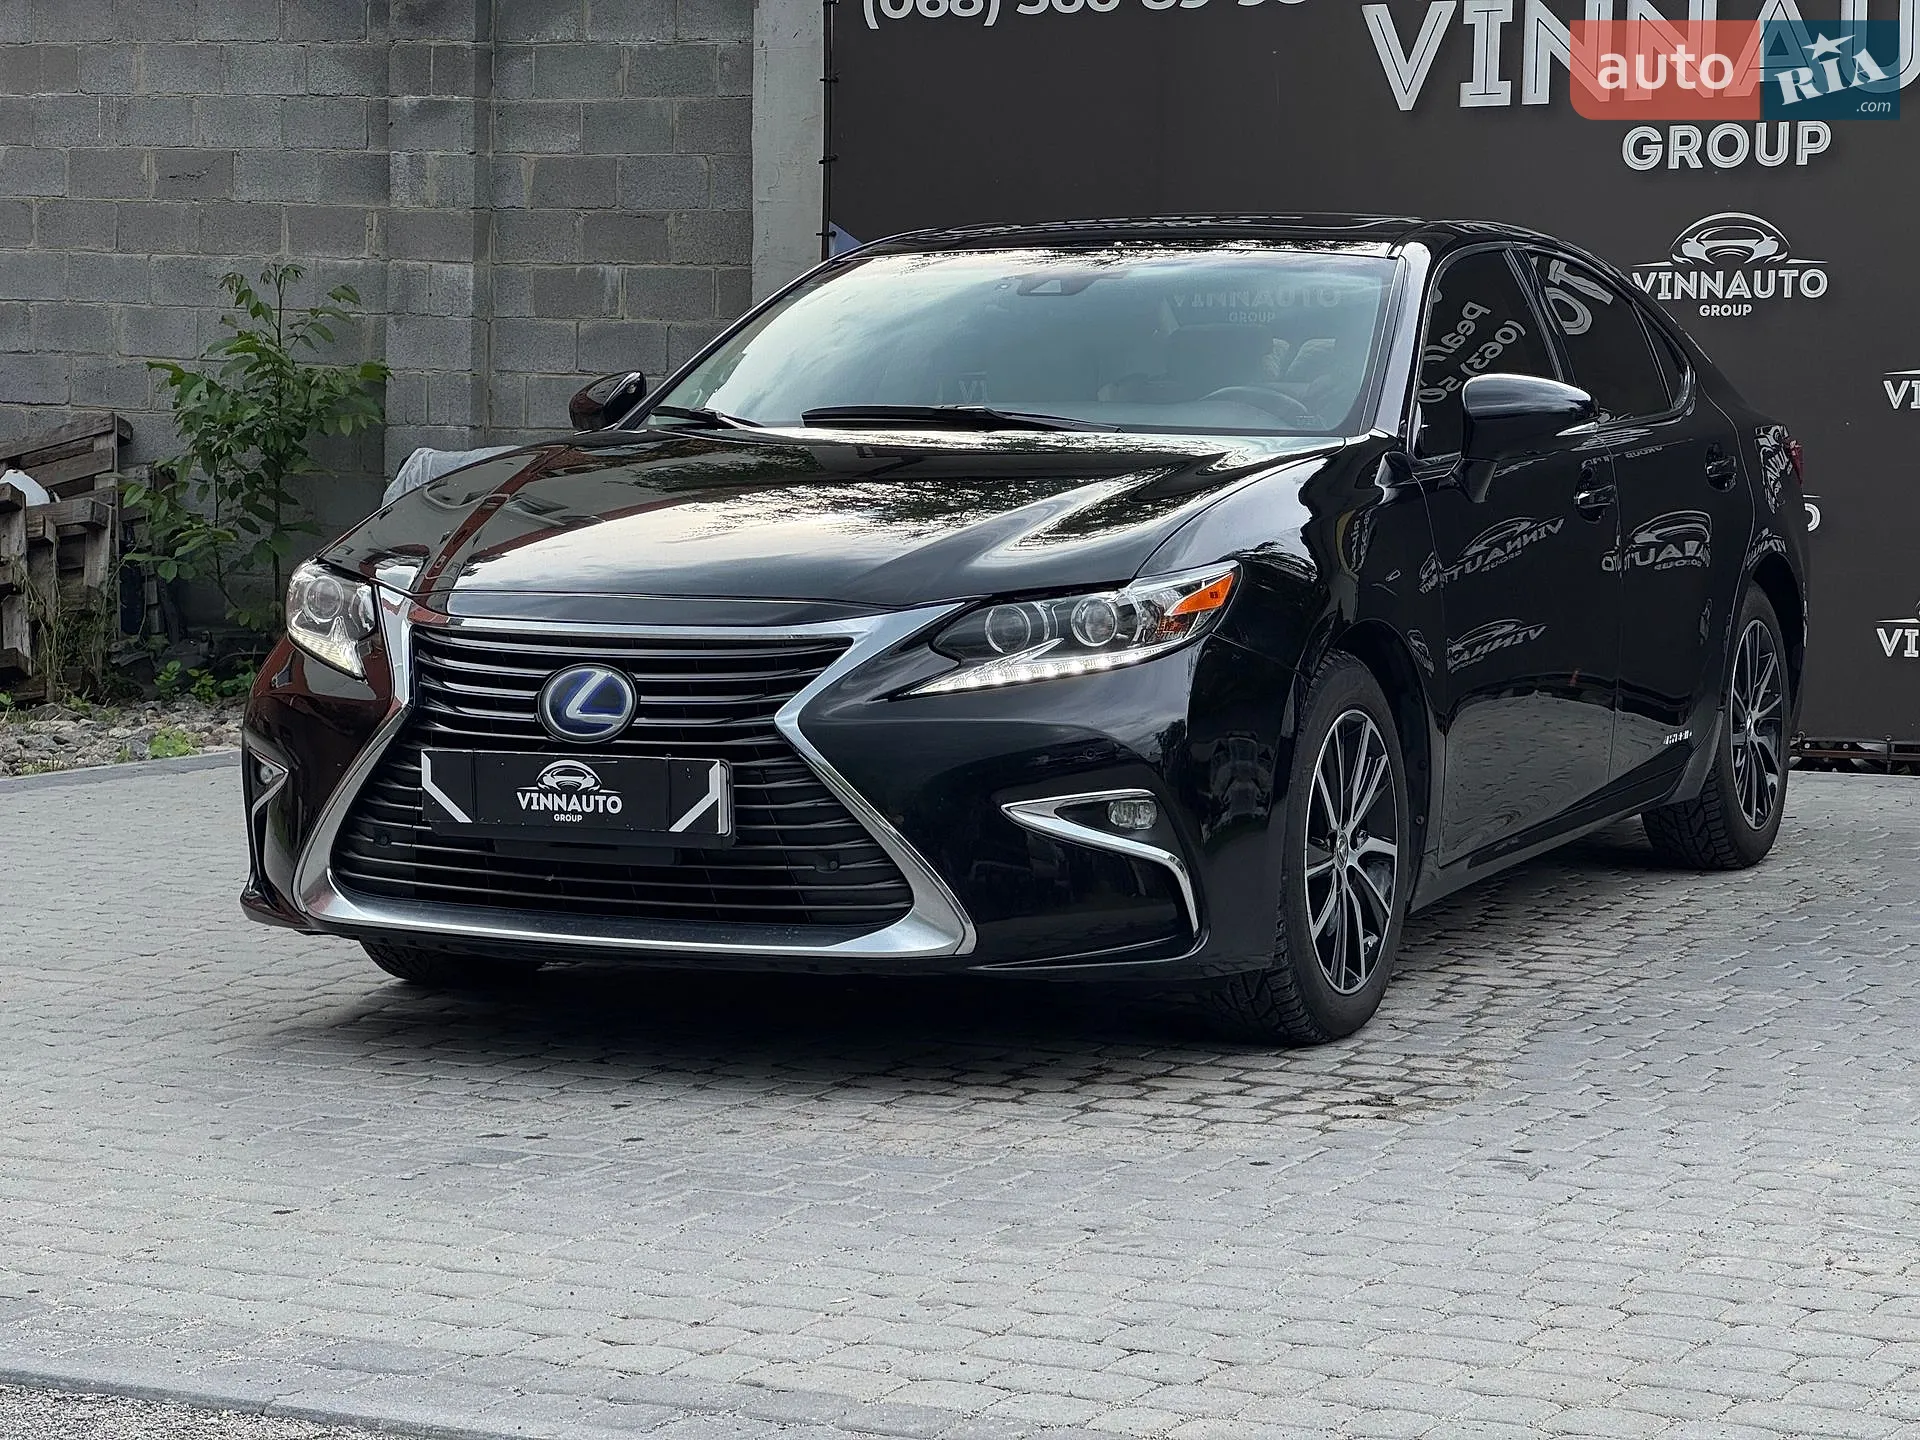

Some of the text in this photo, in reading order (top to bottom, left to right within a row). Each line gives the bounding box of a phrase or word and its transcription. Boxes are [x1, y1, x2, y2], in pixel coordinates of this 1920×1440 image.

[1622, 121, 1832, 170] GROUP
[1632, 268, 1829, 301] VINNAUTO
[1699, 304, 1753, 317] GROUP
[516, 791, 623, 815] VINNAUTO
[553, 813, 583, 824] GROUP
